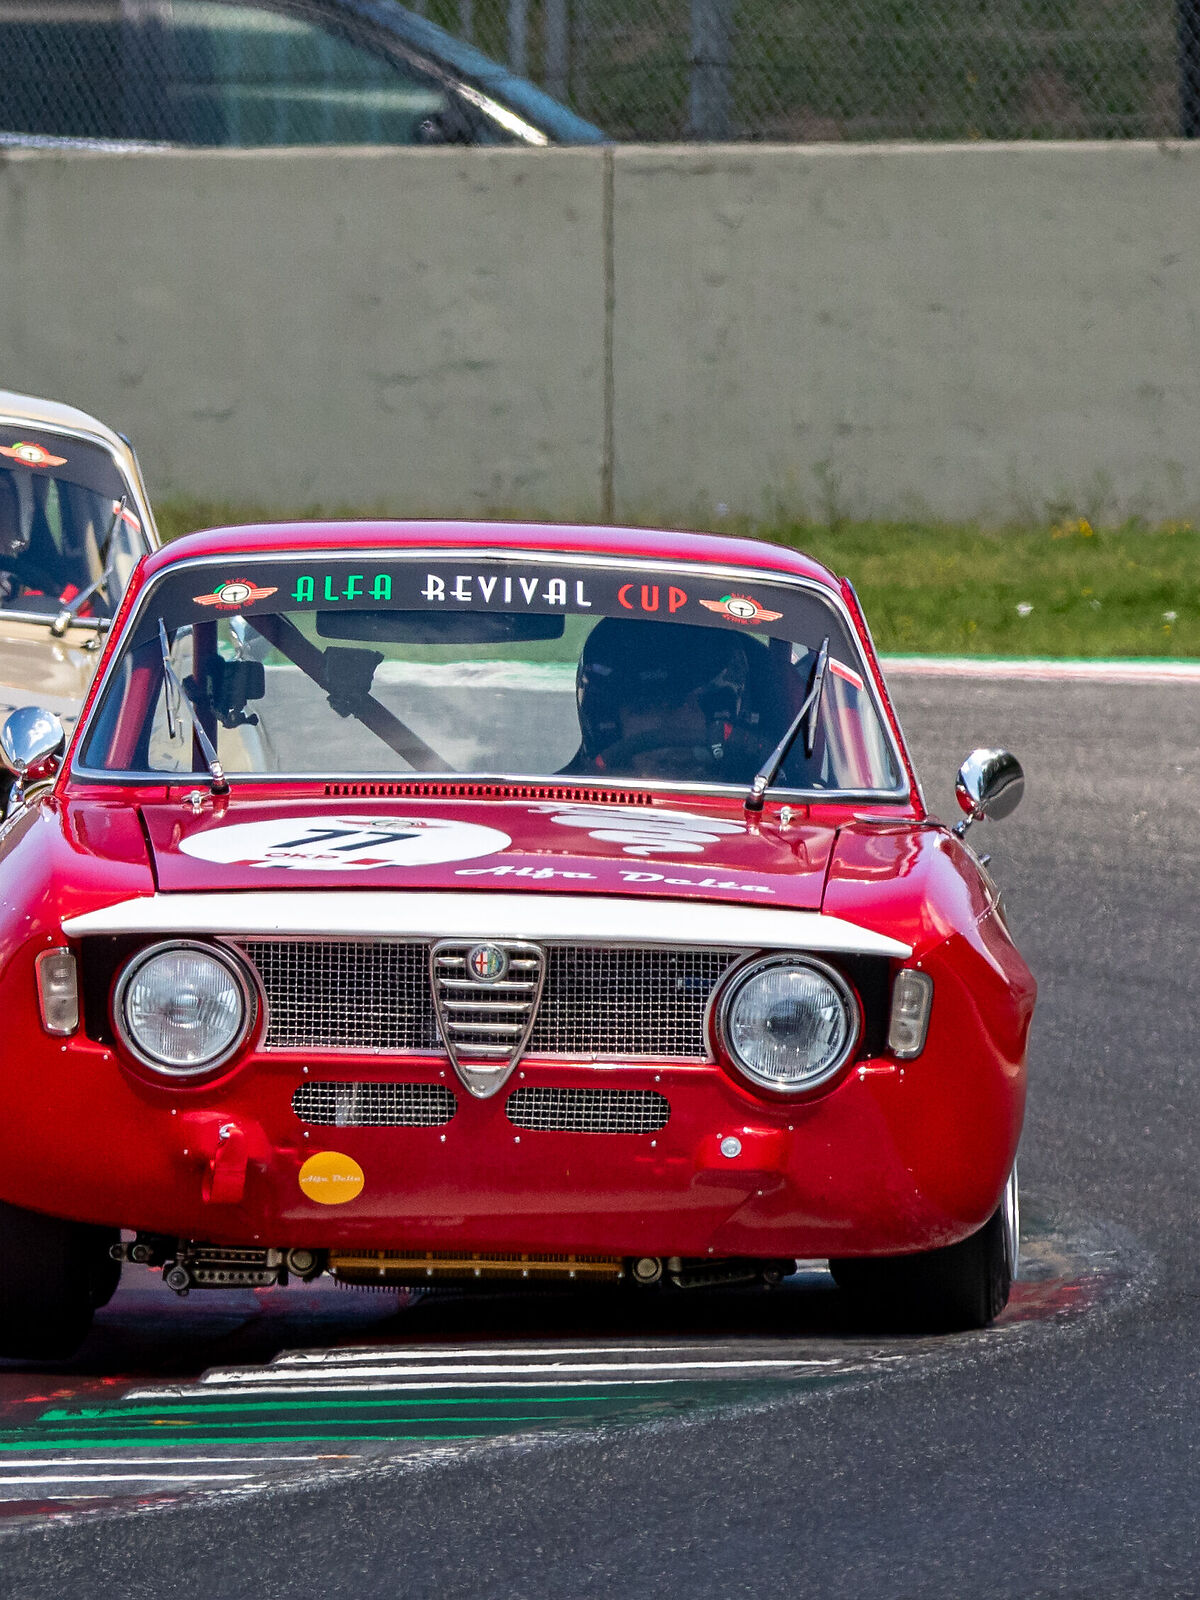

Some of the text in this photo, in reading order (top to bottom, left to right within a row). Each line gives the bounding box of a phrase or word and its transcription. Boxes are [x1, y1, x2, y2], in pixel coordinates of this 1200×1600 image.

[291, 574, 688, 612] ALFA REVIVAL CUP
[268, 829, 422, 851] 77
[454, 865, 776, 894] Alfa Delta
